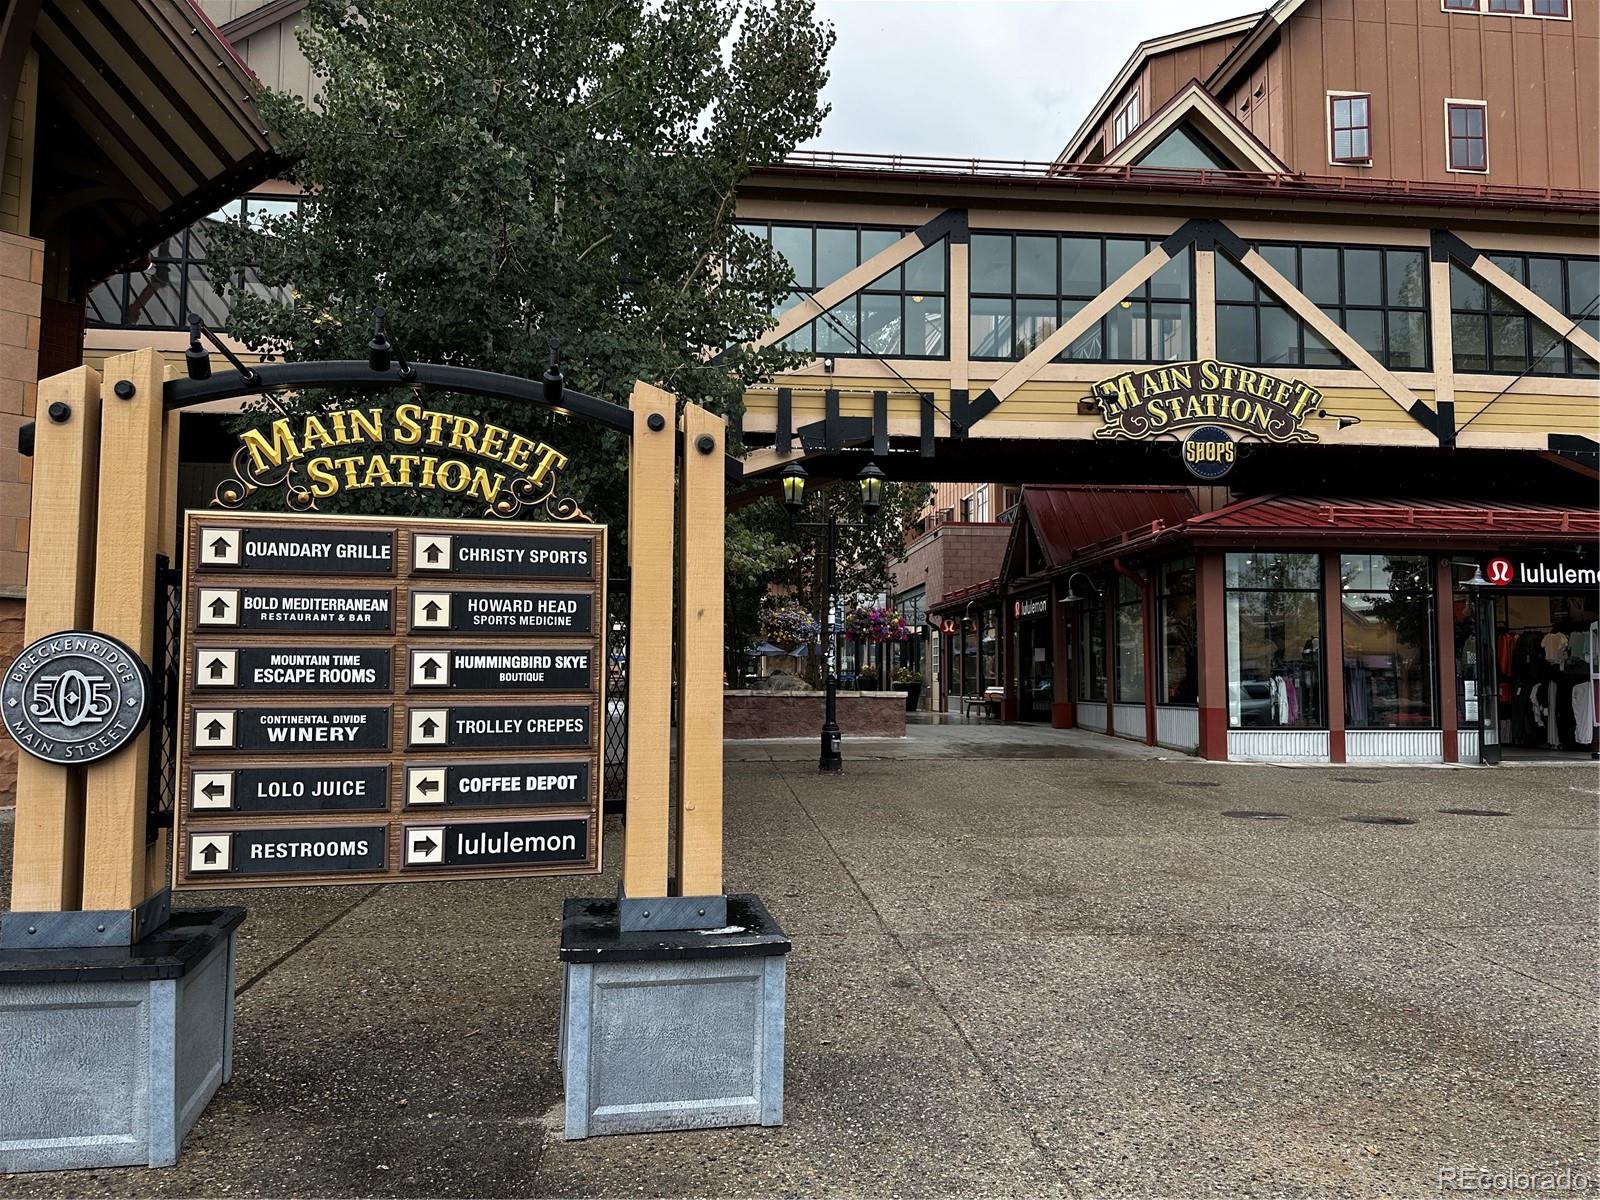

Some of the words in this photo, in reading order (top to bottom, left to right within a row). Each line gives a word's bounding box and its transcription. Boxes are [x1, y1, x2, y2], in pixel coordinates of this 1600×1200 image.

[1100, 366, 1191, 415] MAIN
[1200, 361, 1317, 420] STREET
[1148, 394, 1273, 430] STATION
[239, 407, 383, 476] MAIN
[393, 404, 568, 488] STREET
[1186, 440, 1234, 463] SHOPS
[306, 455, 506, 504] STATION
[246, 542, 331, 557] QUANDARY
[336, 544, 390, 559] GRILLE
[460, 548, 525, 562] CHRISTY
[530, 550, 587, 564] SPORTS
[1521, 562, 1600, 584] lululem
[244, 597, 278, 609] BOLD
[282, 598, 388, 611] MEDITERRANEAN
[469, 599, 532, 612] HOWARD
[538, 600, 576, 613] HEAD
[1021, 600, 1047, 615] lululemon
[261, 613, 334, 621] RESTAURANT
[474, 615, 516, 625] SPORTS
[520, 616, 571, 625] MEDICINE
[12, 639, 134, 684] BRECKENRIDGE
[271, 655, 329, 665] MOUNTAIN
[333, 656, 360, 665] TIME
[455, 656, 551, 668] HUMMINGBIRD
[555, 656, 587, 668] SKYE
[254, 669, 315, 682] ESCAPE
[320, 669, 375, 682] ROOMS
[500, 673, 544, 681] BOUTIQUE
[30, 670, 112, 726] 505
[260, 716, 329, 724] CONTINENTAL
[333, 715, 366, 723] DIVIDE
[456, 720, 522, 733] TROLLEY
[527, 719, 583, 732] CREPES
[13, 721, 53, 753] MAIN
[65, 720, 127, 757] STREET
[267, 727, 359, 741] WINERY
[258, 782, 304, 797] LOLO
[312, 781, 365, 796] JUICE
[459, 777, 520, 792] COFFEE
[526, 775, 577, 790] DEPOT
[251, 841, 368, 858] RESTROOMS
[458, 832, 575, 854] lululemon
